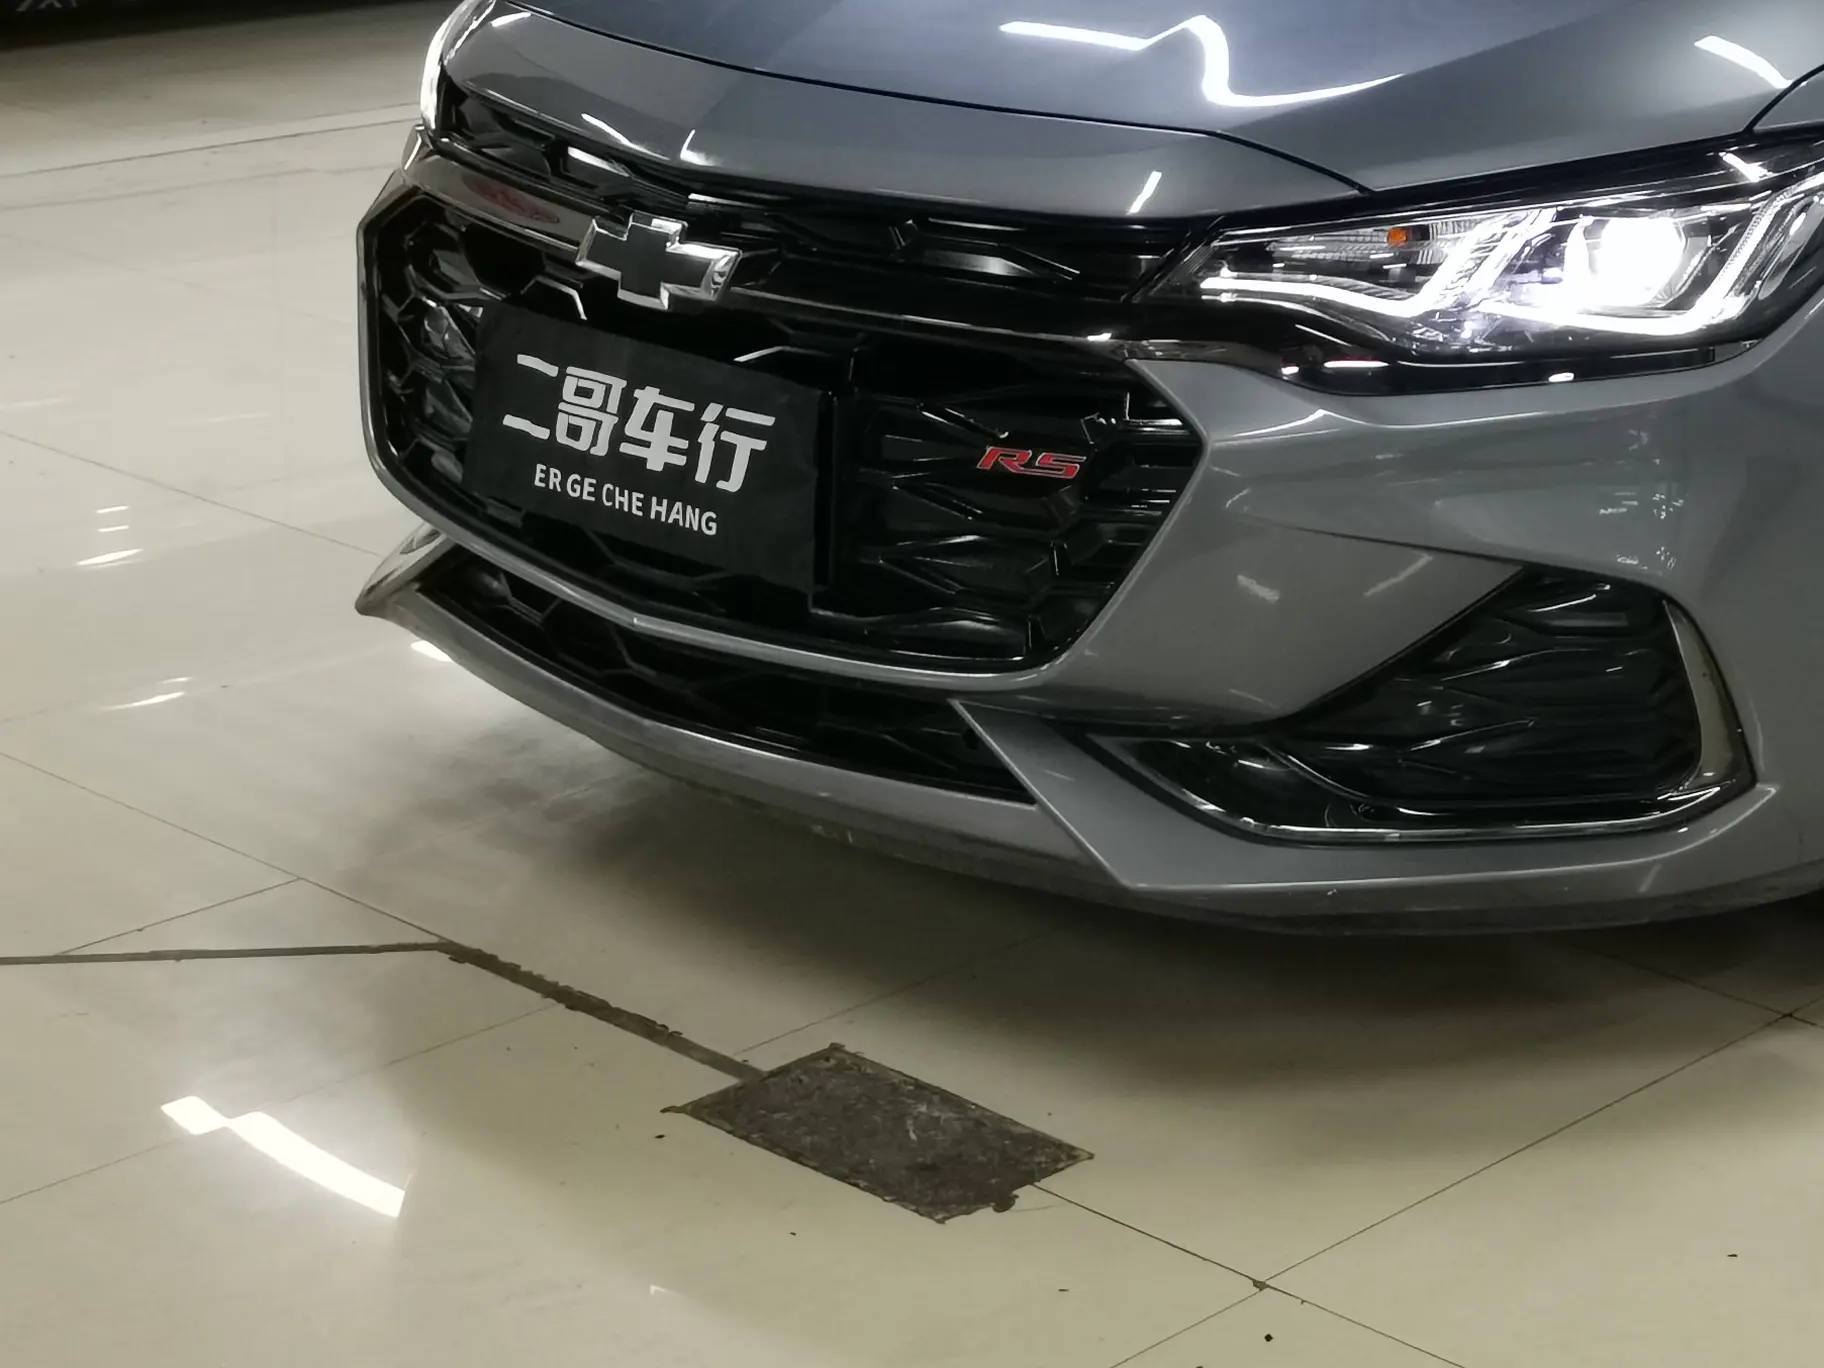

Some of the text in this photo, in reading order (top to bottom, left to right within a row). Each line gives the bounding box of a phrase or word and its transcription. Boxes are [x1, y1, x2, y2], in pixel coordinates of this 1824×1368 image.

[503, 354, 776, 493] 二哥车行
[976, 446, 1087, 479] RS
[533, 464, 718, 536] ER GE CHE HANG
